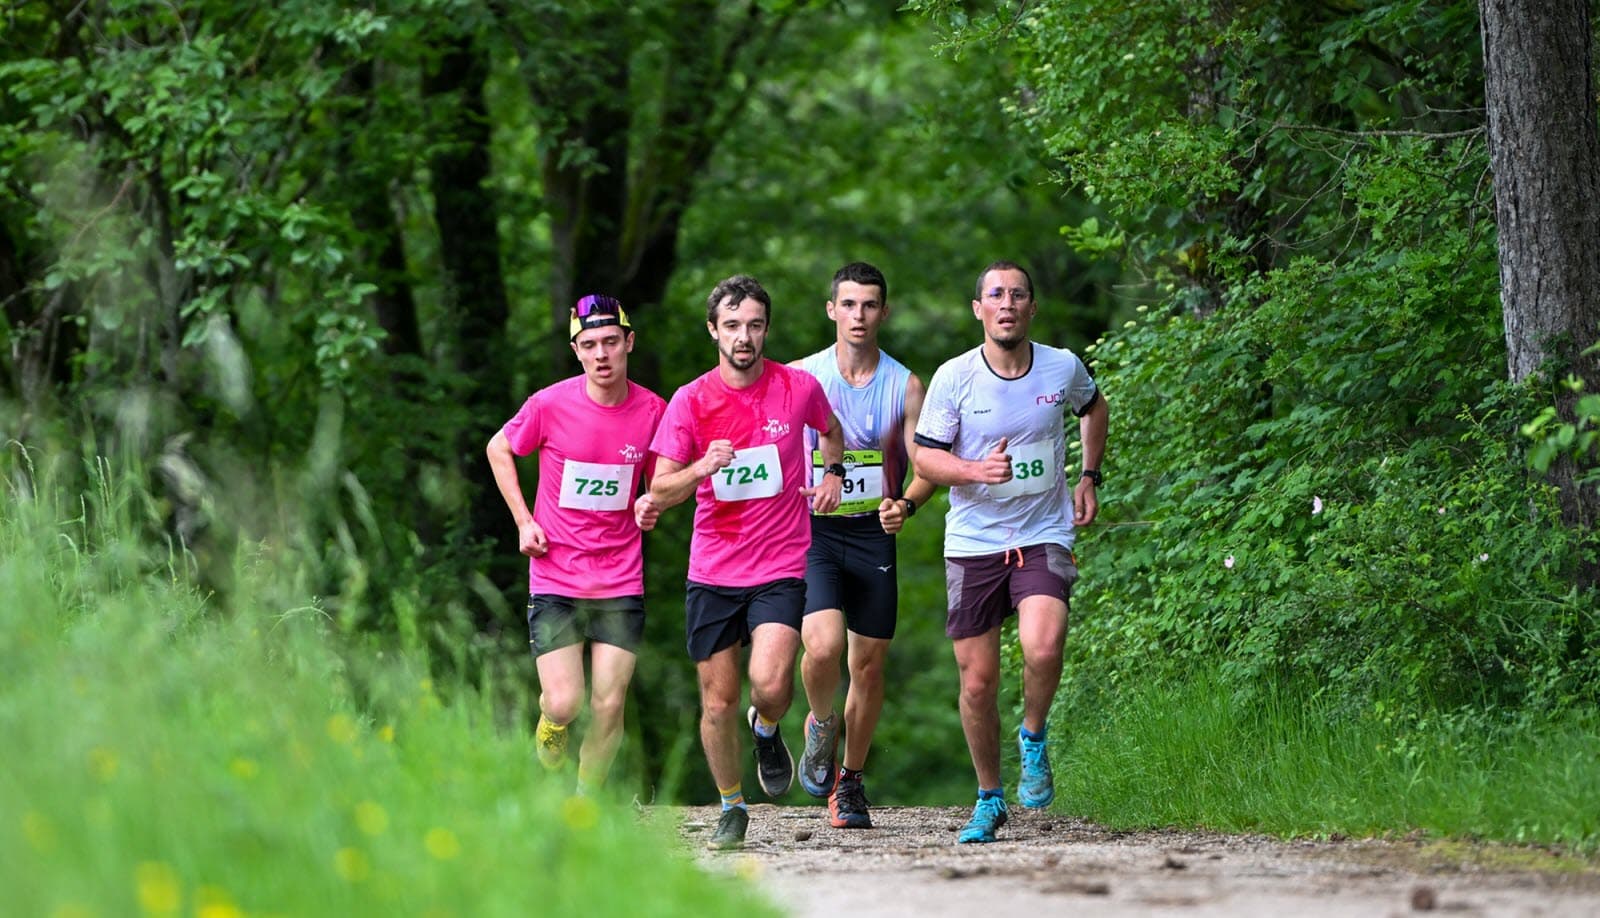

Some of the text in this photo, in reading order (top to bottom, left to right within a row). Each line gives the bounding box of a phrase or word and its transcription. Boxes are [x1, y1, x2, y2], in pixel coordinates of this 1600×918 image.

[721, 463, 769, 486] 724
[1014, 458, 1045, 480] 38
[574, 477, 619, 497] 725
[842, 478, 865, 494] 91
